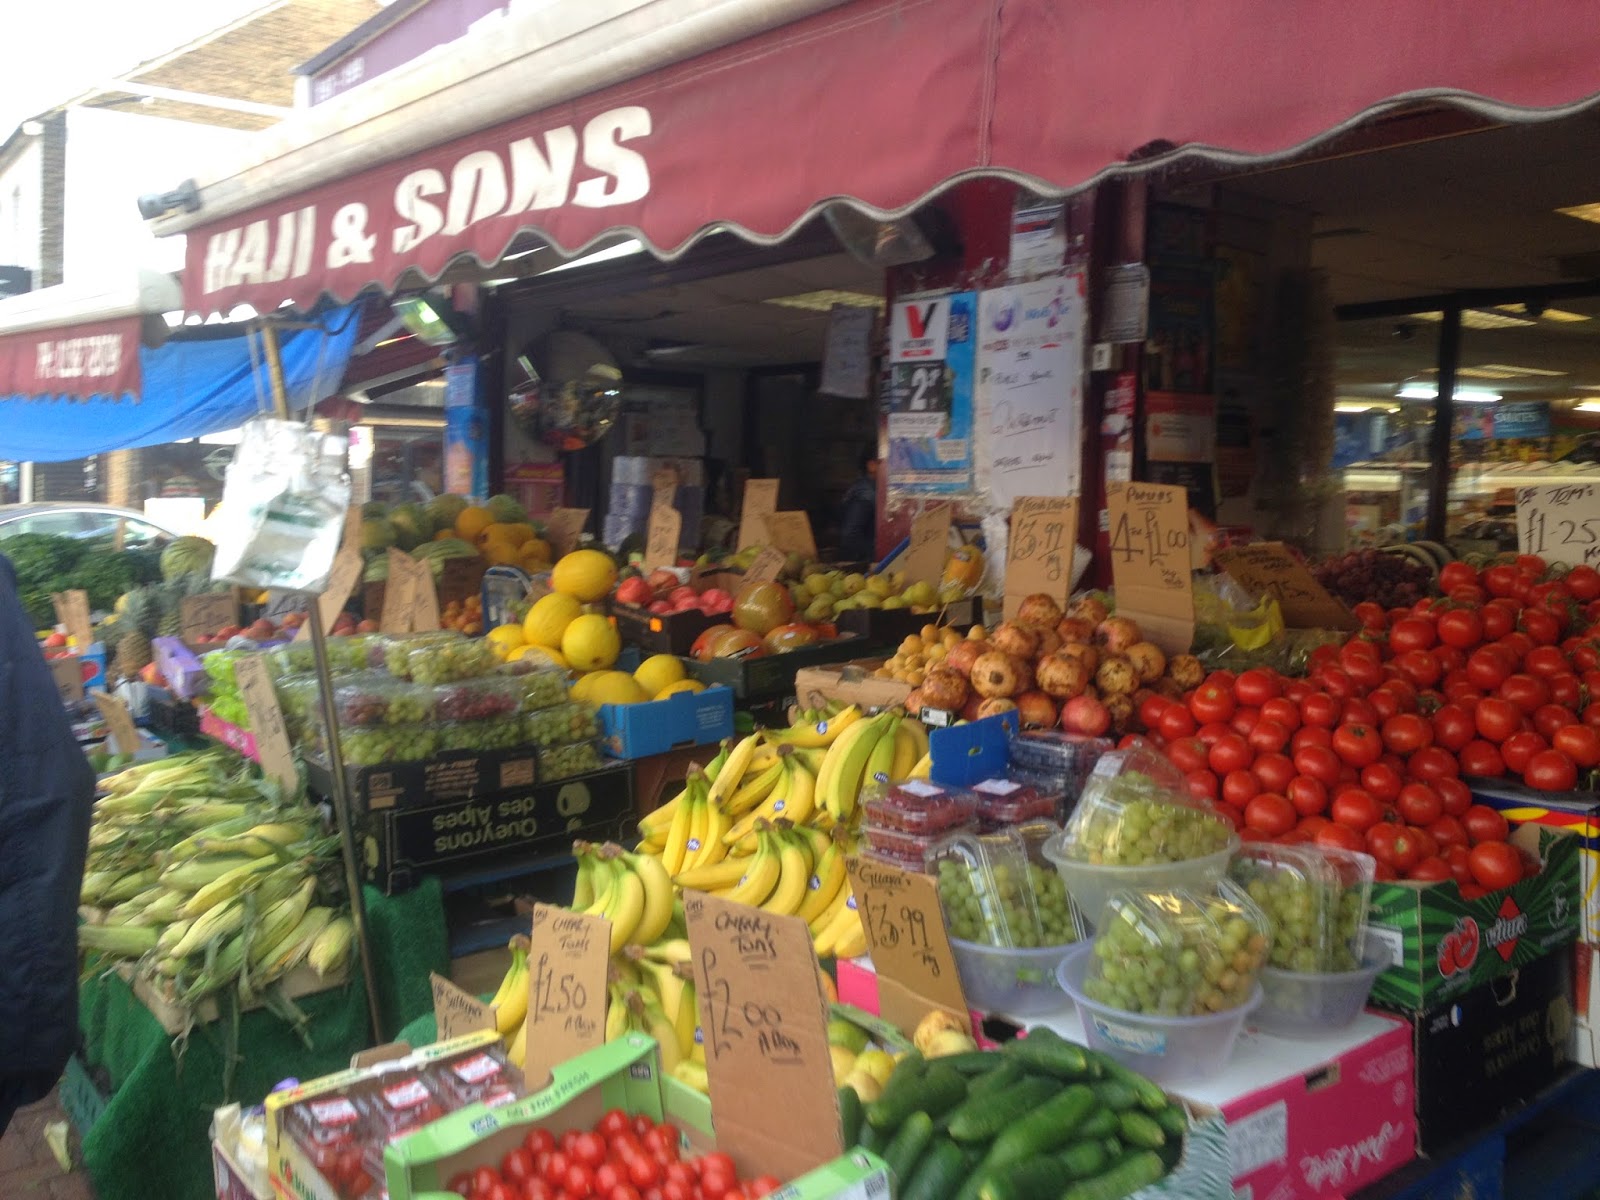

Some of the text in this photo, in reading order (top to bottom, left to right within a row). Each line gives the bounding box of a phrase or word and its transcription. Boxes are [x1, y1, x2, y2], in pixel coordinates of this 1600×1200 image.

[203, 106, 653, 294] HAJI & SONS
[1112, 511, 1143, 563] 4
[432, 796, 537, 832] des Alpes
[434, 817, 538, 853] Queyrons
